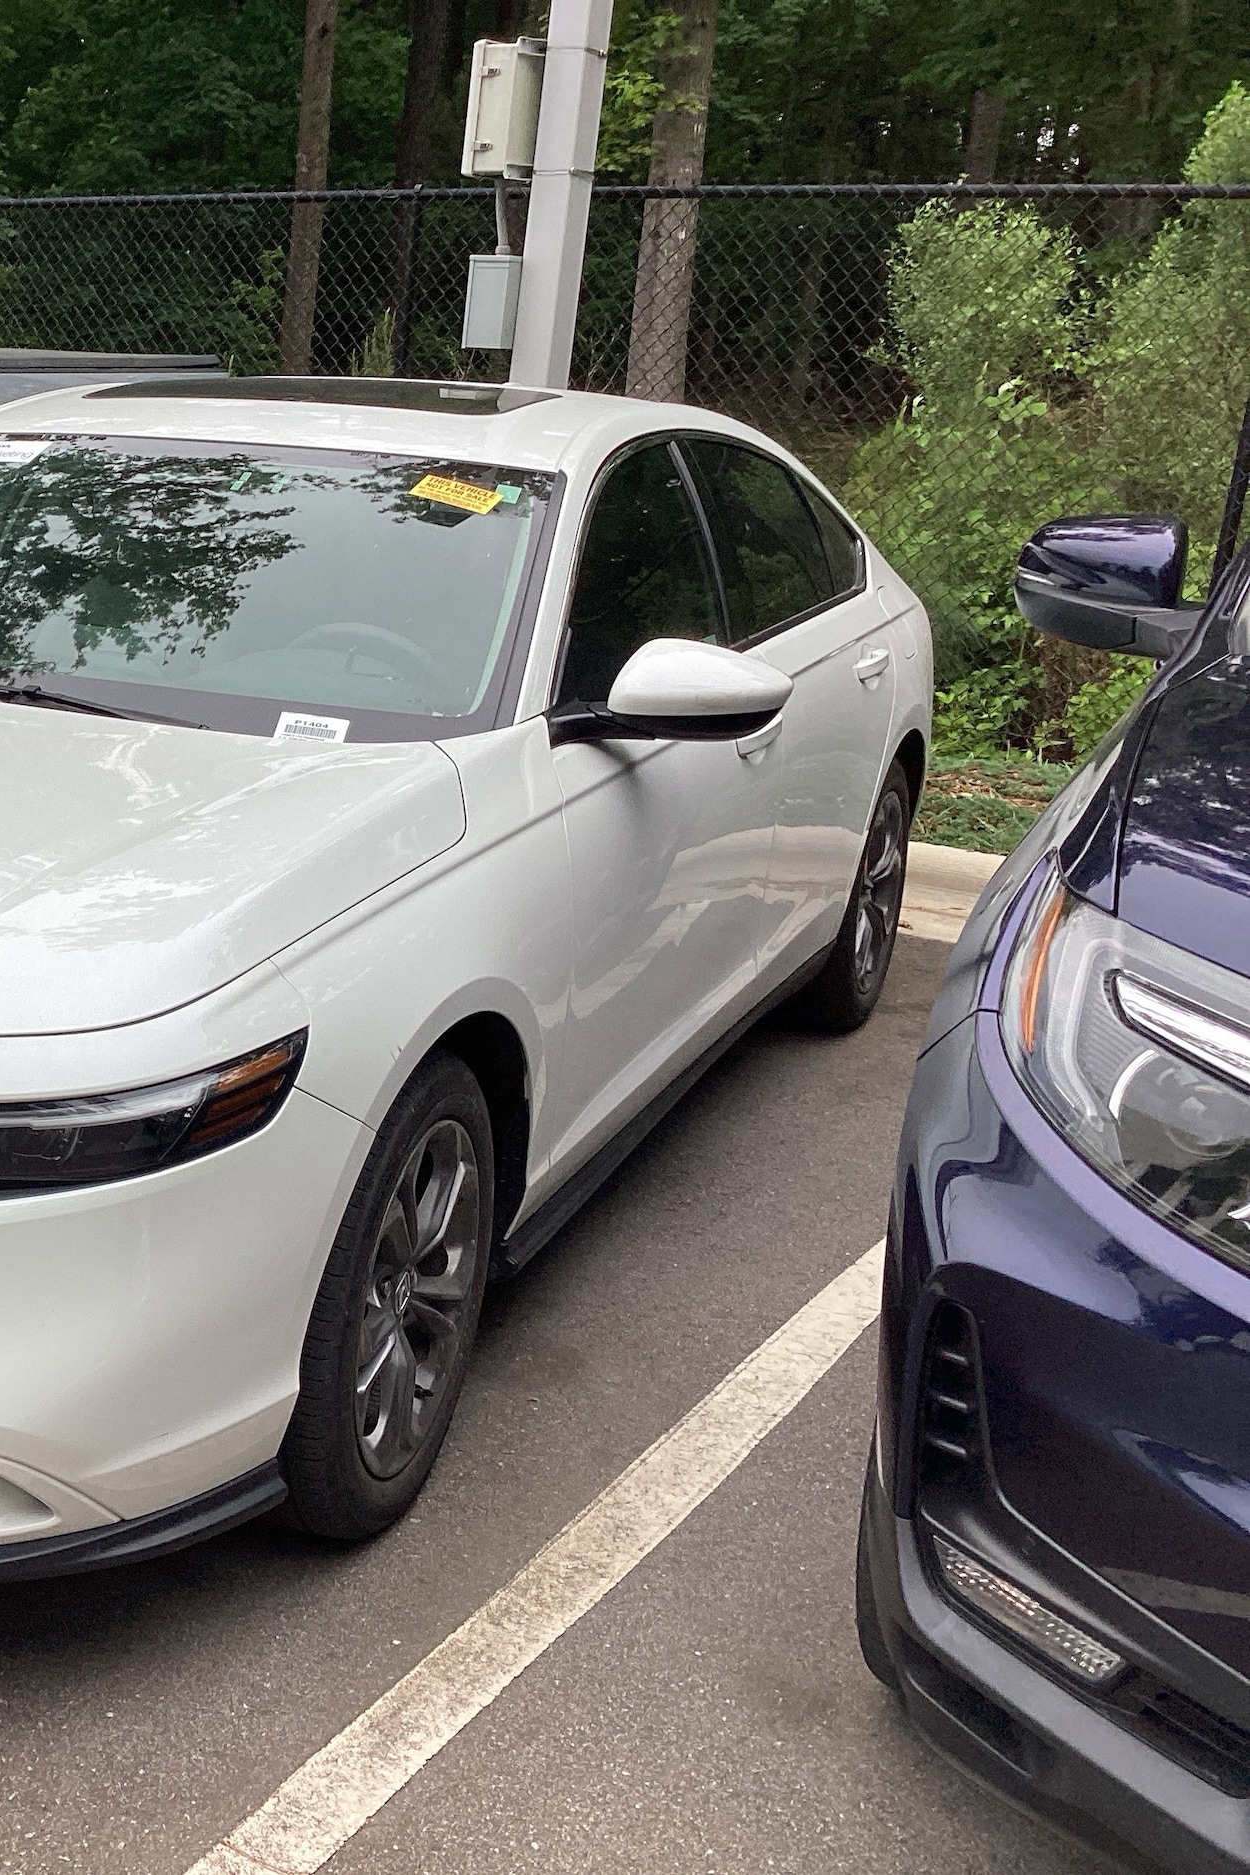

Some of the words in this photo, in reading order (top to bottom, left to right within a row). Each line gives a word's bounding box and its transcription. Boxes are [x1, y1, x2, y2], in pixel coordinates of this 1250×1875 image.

[425, 482, 444, 491] NOT
[445, 487, 465, 496] FOR
[465, 493, 491, 503] SALE
[428, 477, 451, 487] THIS
[454, 482, 499, 500] VEHICLE
[294, 719, 329, 729] P1404
